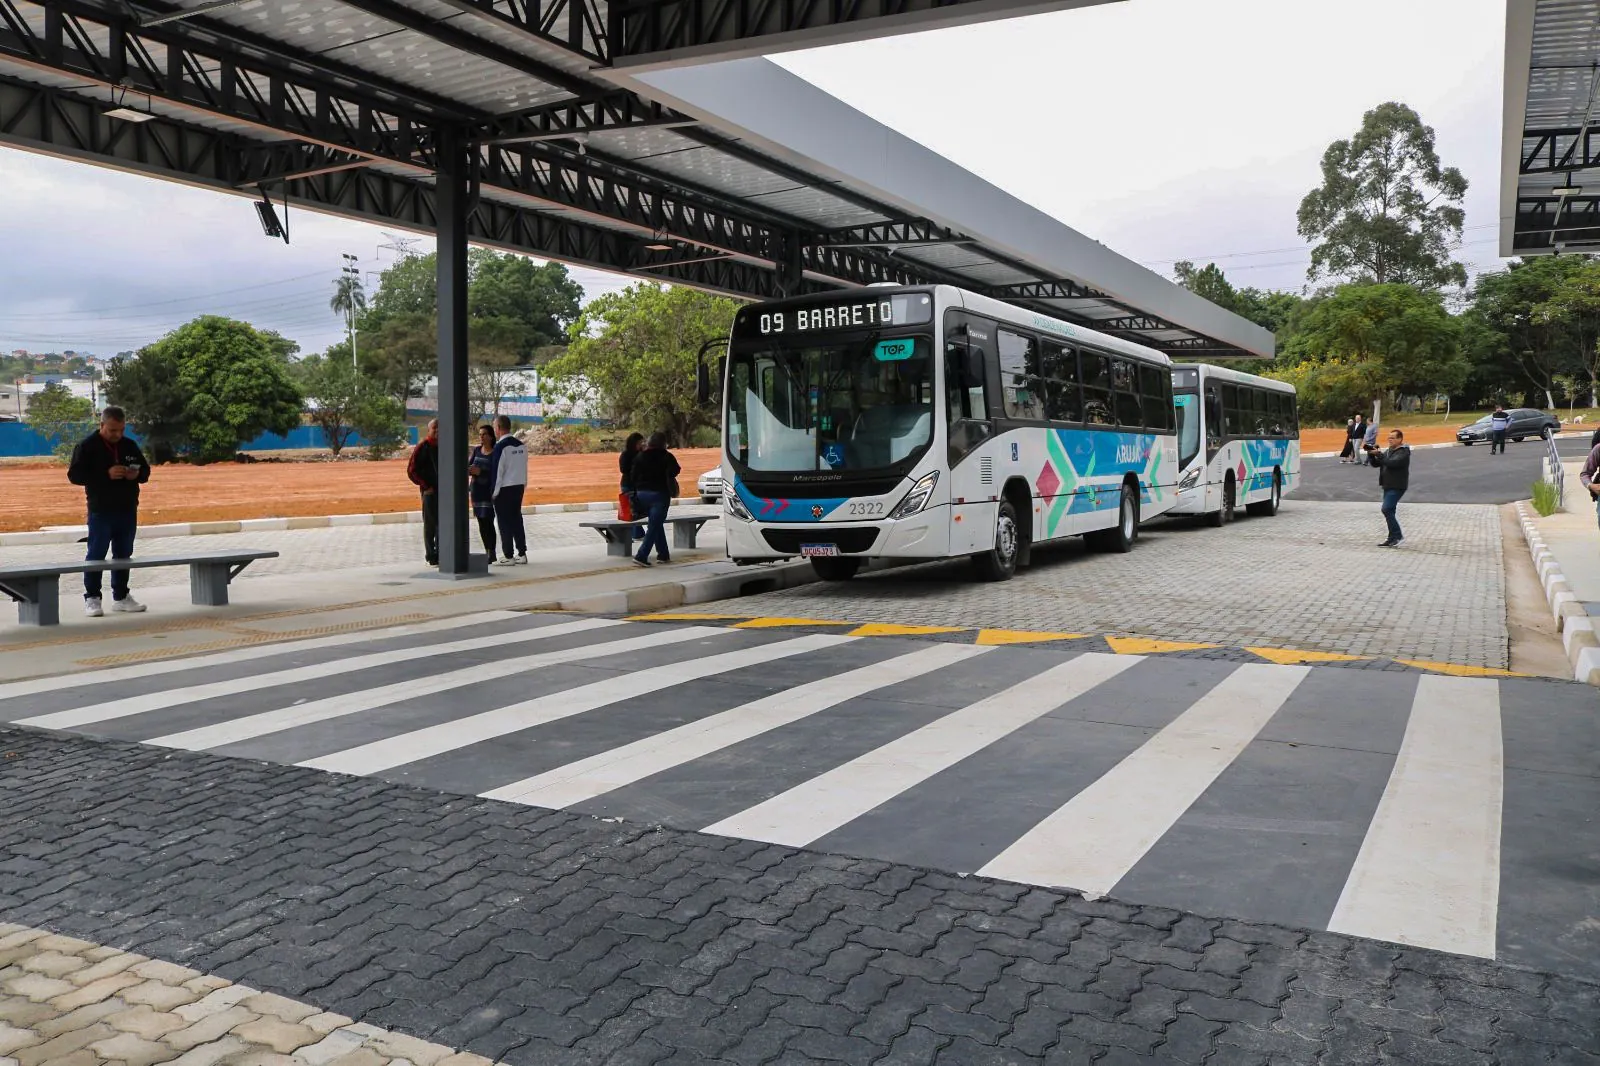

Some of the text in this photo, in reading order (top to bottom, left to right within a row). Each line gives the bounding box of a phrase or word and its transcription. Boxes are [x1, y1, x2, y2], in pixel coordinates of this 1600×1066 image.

[760, 301, 892, 334] 09 BARRETO
[881, 345, 906, 356] TOP
[849, 502, 884, 515] 2322
